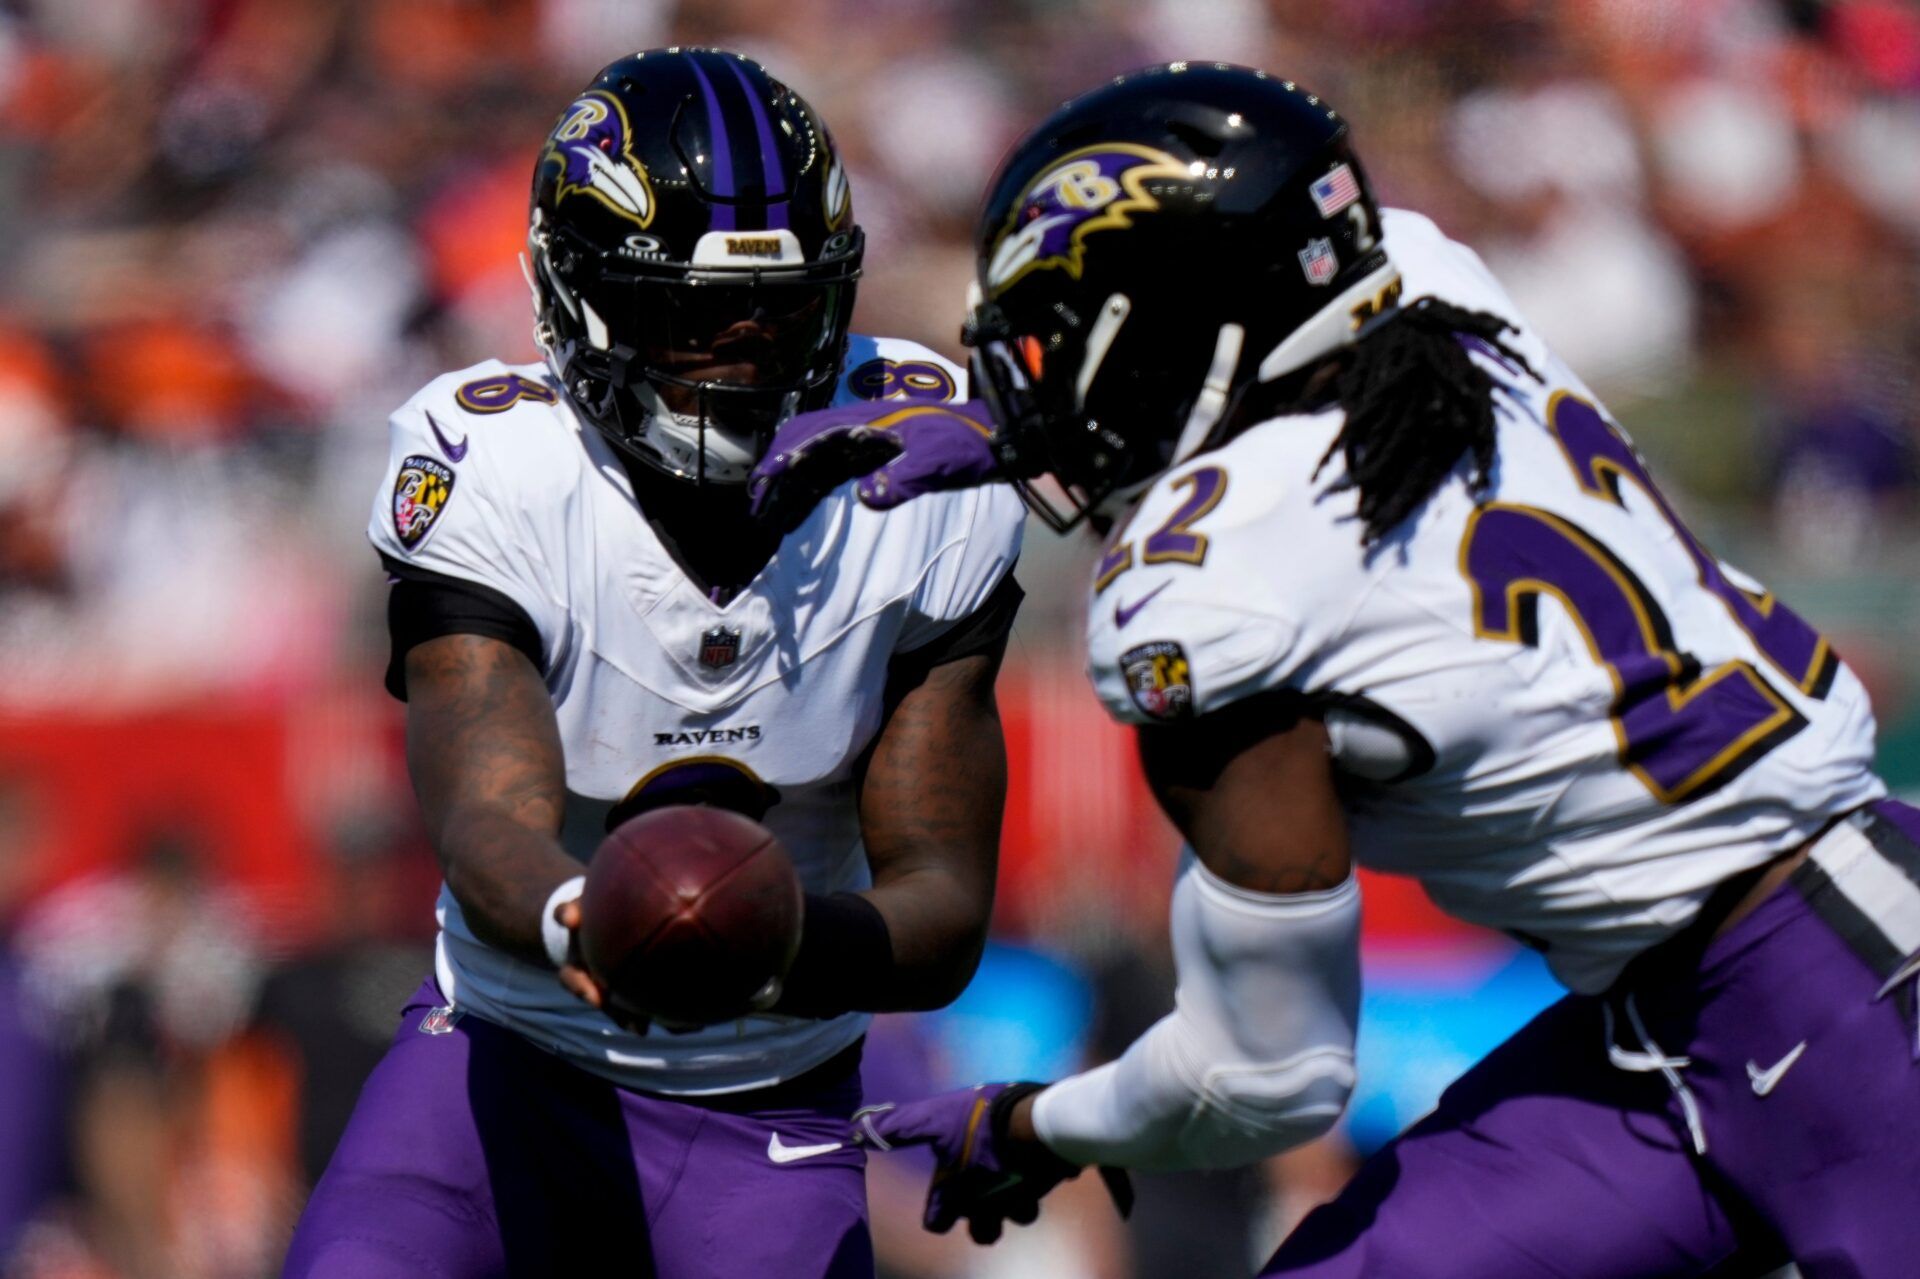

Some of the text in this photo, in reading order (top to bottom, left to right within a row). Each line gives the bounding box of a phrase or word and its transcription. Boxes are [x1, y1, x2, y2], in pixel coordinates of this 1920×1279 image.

[618, 246, 667, 262] OAKLEY
[726, 236, 782, 256] RAVENS
[848, 356, 958, 402] 8
[405, 457, 451, 483] RAVENS
[1459, 389, 1840, 805] 22
[653, 725, 761, 746] RAVENS
